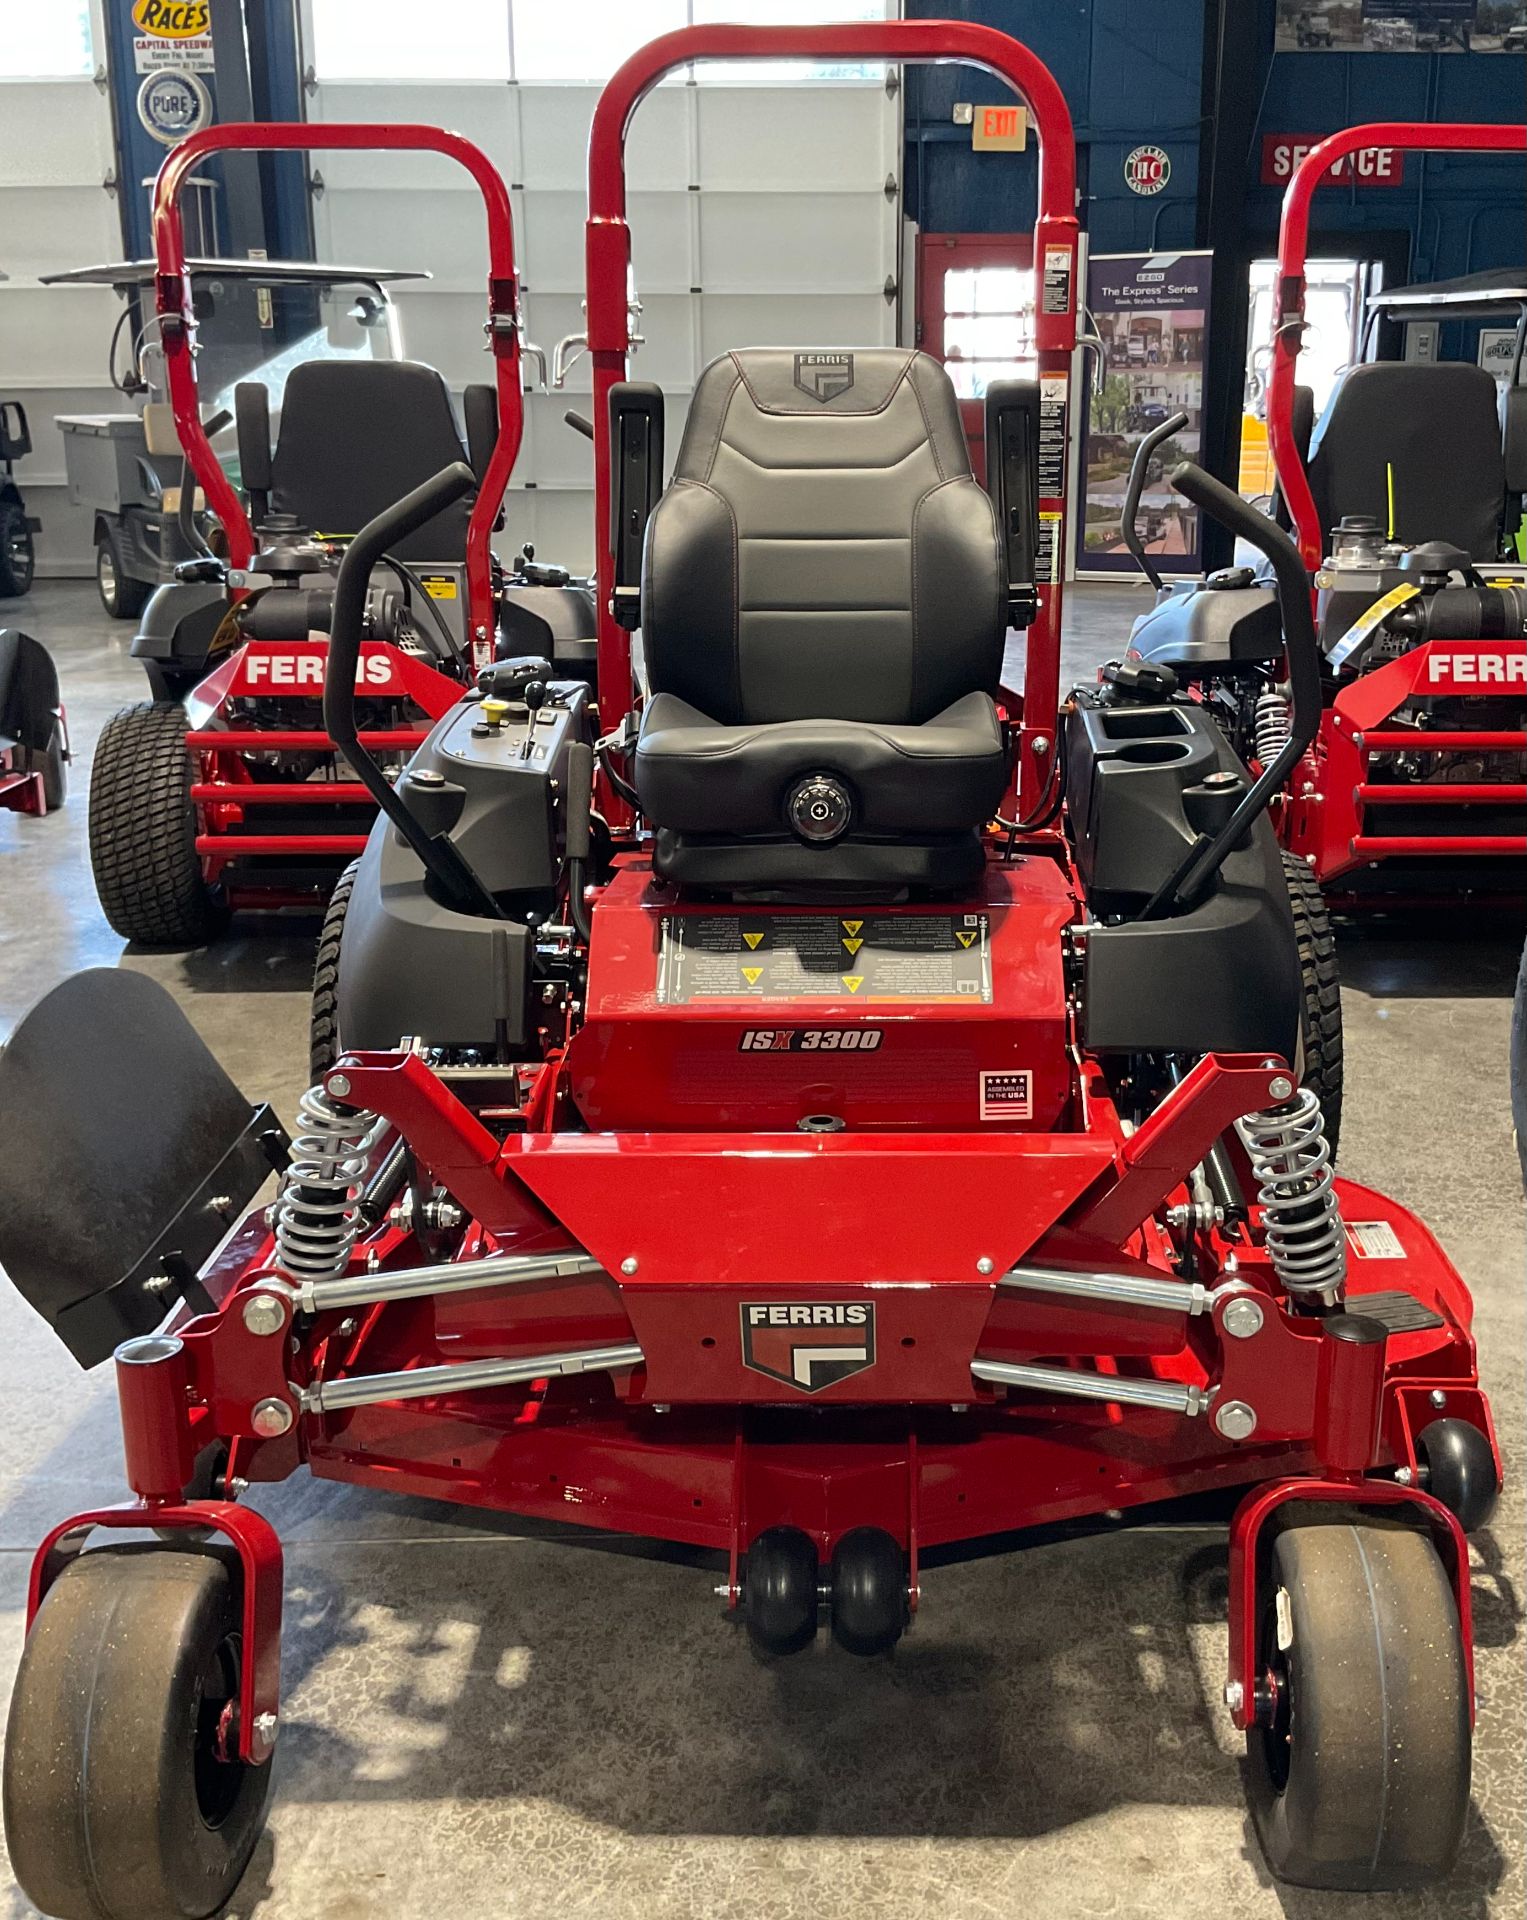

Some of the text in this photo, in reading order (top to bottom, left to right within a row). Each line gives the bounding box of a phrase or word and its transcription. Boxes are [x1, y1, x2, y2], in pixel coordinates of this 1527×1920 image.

[140, 0, 208, 29] RACES
[135, 40, 171, 50] CAPITAL
[153, 96, 189, 113] PURE
[984, 109, 1017, 137] EXIT
[1274, 146, 1391, 176] SEVICE
[1102, 287, 1120, 297] The
[1167, 284, 1198, 295] Series
[799, 355, 849, 364] FERRIS
[247, 655, 392, 684] FERIS
[741, 1031, 881, 1050] ISX 3300
[749, 1305, 867, 1325] FERRIS
